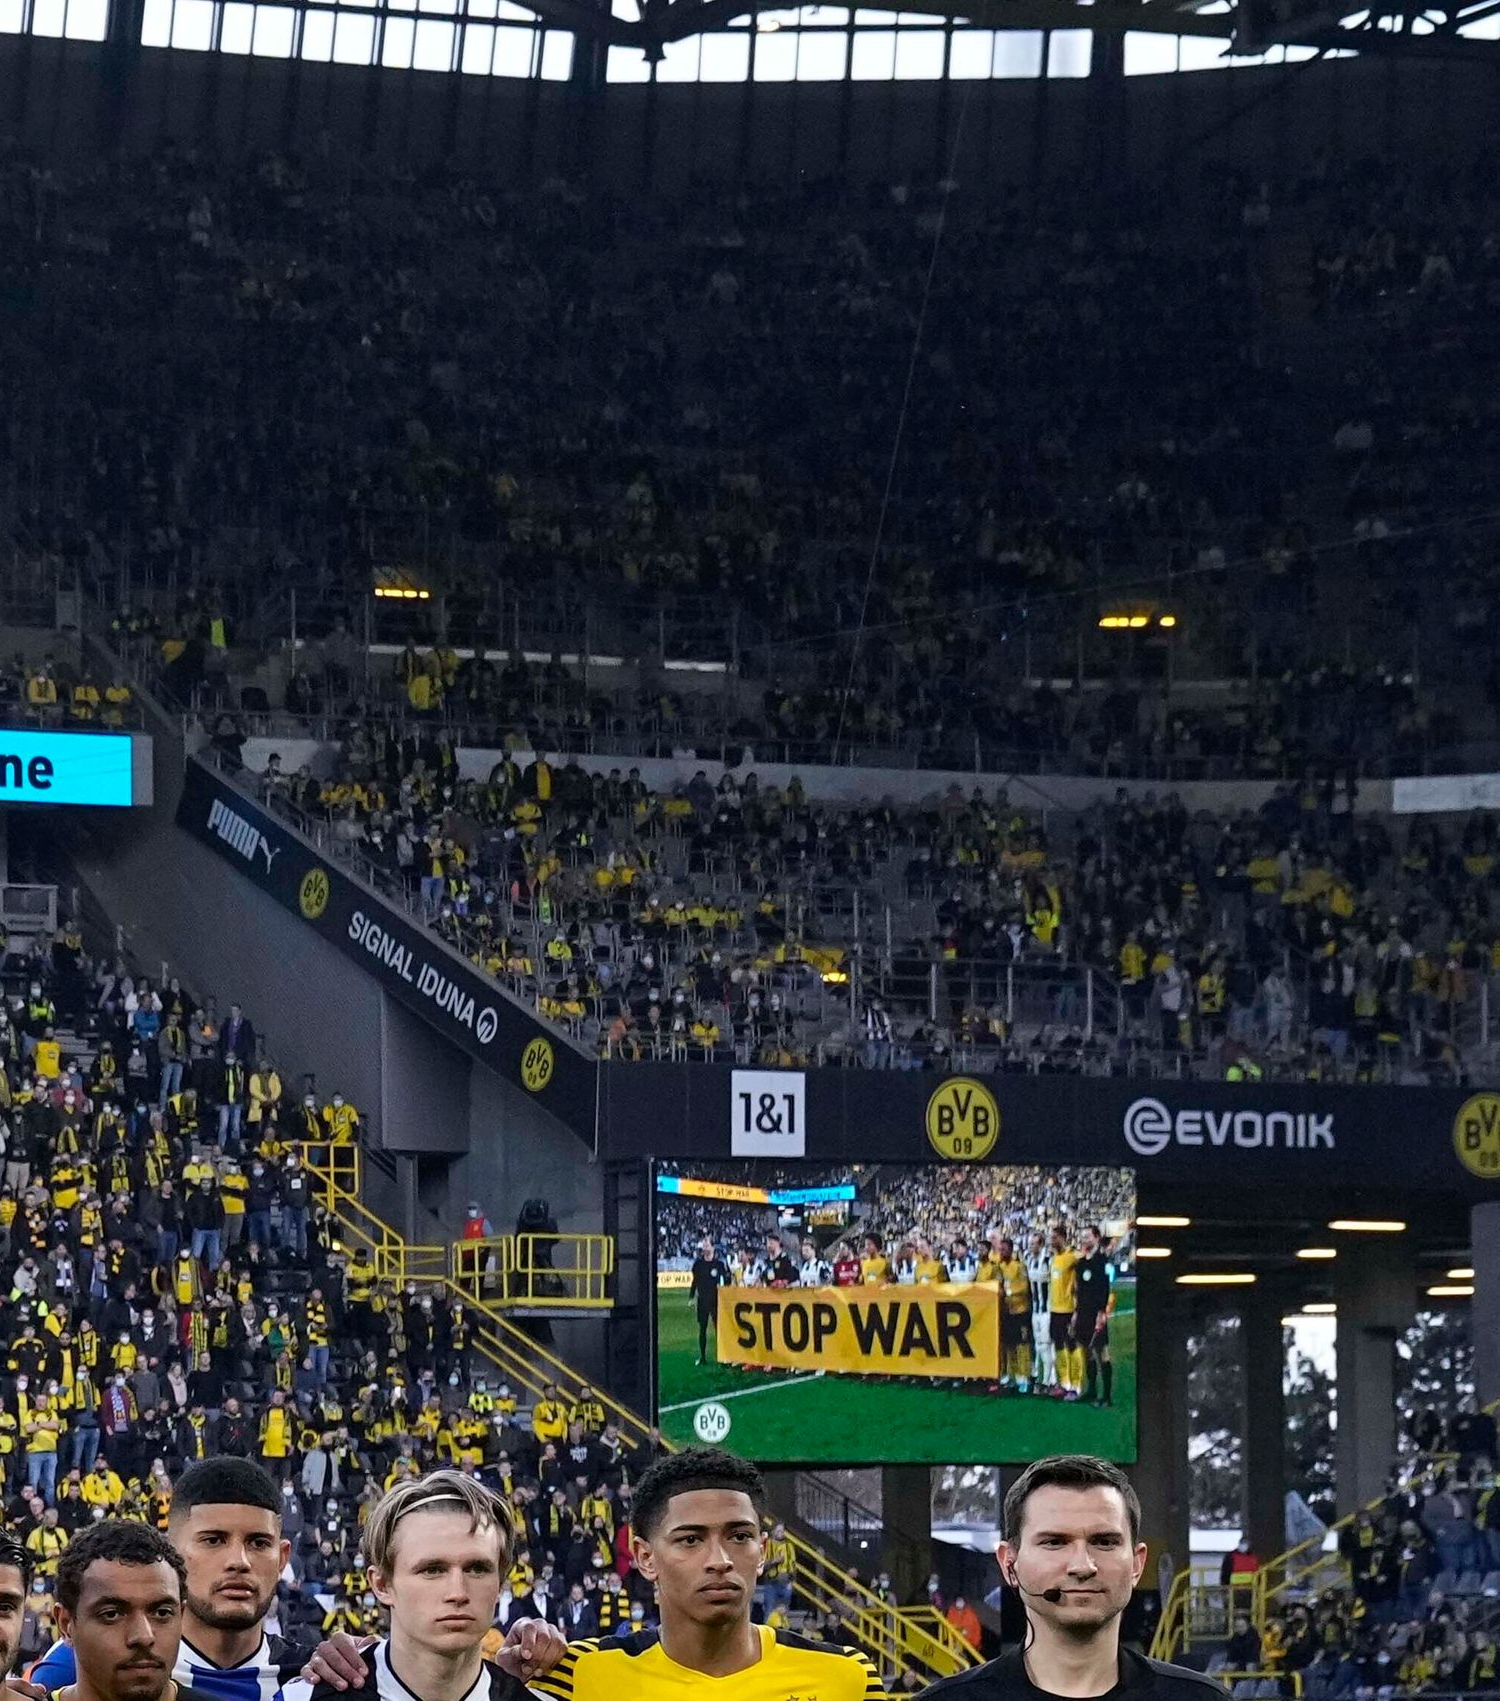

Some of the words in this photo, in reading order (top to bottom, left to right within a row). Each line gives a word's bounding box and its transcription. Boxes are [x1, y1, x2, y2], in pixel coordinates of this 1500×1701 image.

[206, 799, 261, 861] PUMA
[303, 872, 325, 904] BVB
[348, 911, 414, 983] SIGNAL
[416, 963, 476, 1032] IDUNA
[525, 1045, 549, 1080] BVB
[739, 1092, 795, 1135] 1&1
[937, 1088, 989, 1137] BVB
[1175, 1110, 1336, 1148] EVONIK
[1465, 1103, 1500, 1151] BV
[733, 1302, 837, 1353] STOP
[849, 1301, 976, 1359] WAR
[699, 1406, 726, 1430] BVB
